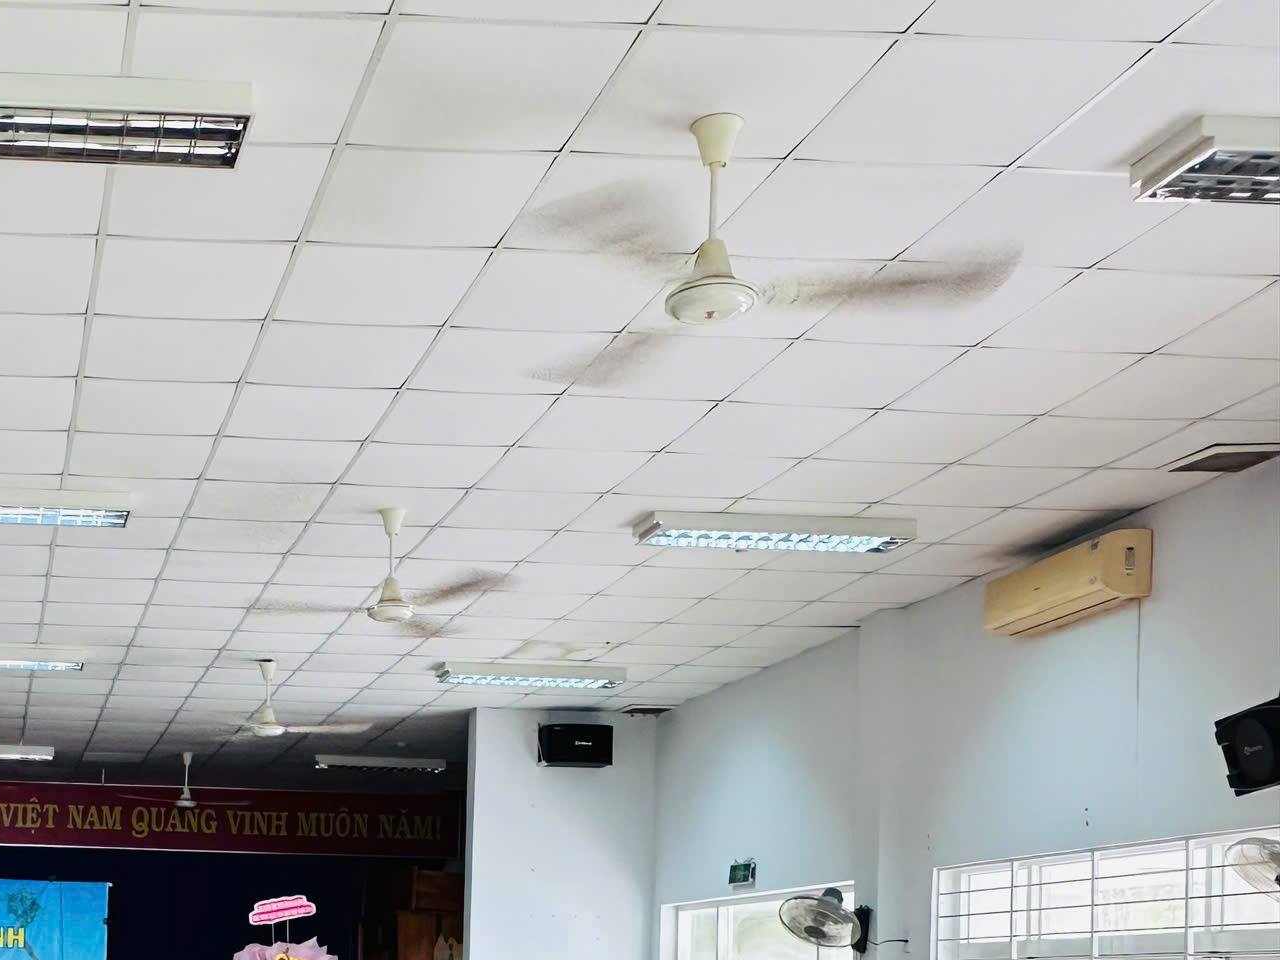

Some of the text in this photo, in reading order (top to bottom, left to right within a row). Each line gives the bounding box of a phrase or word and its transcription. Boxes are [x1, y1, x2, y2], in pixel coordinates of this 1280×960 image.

[0, 797, 59, 834] VIỆT
[67, 805, 122, 831] NAM
[131, 806, 218, 838] QUANG
[227, 812, 288, 837] VINH
[296, 807, 370, 839] MUÔN
[375, 807, 441, 841] NĂM!
